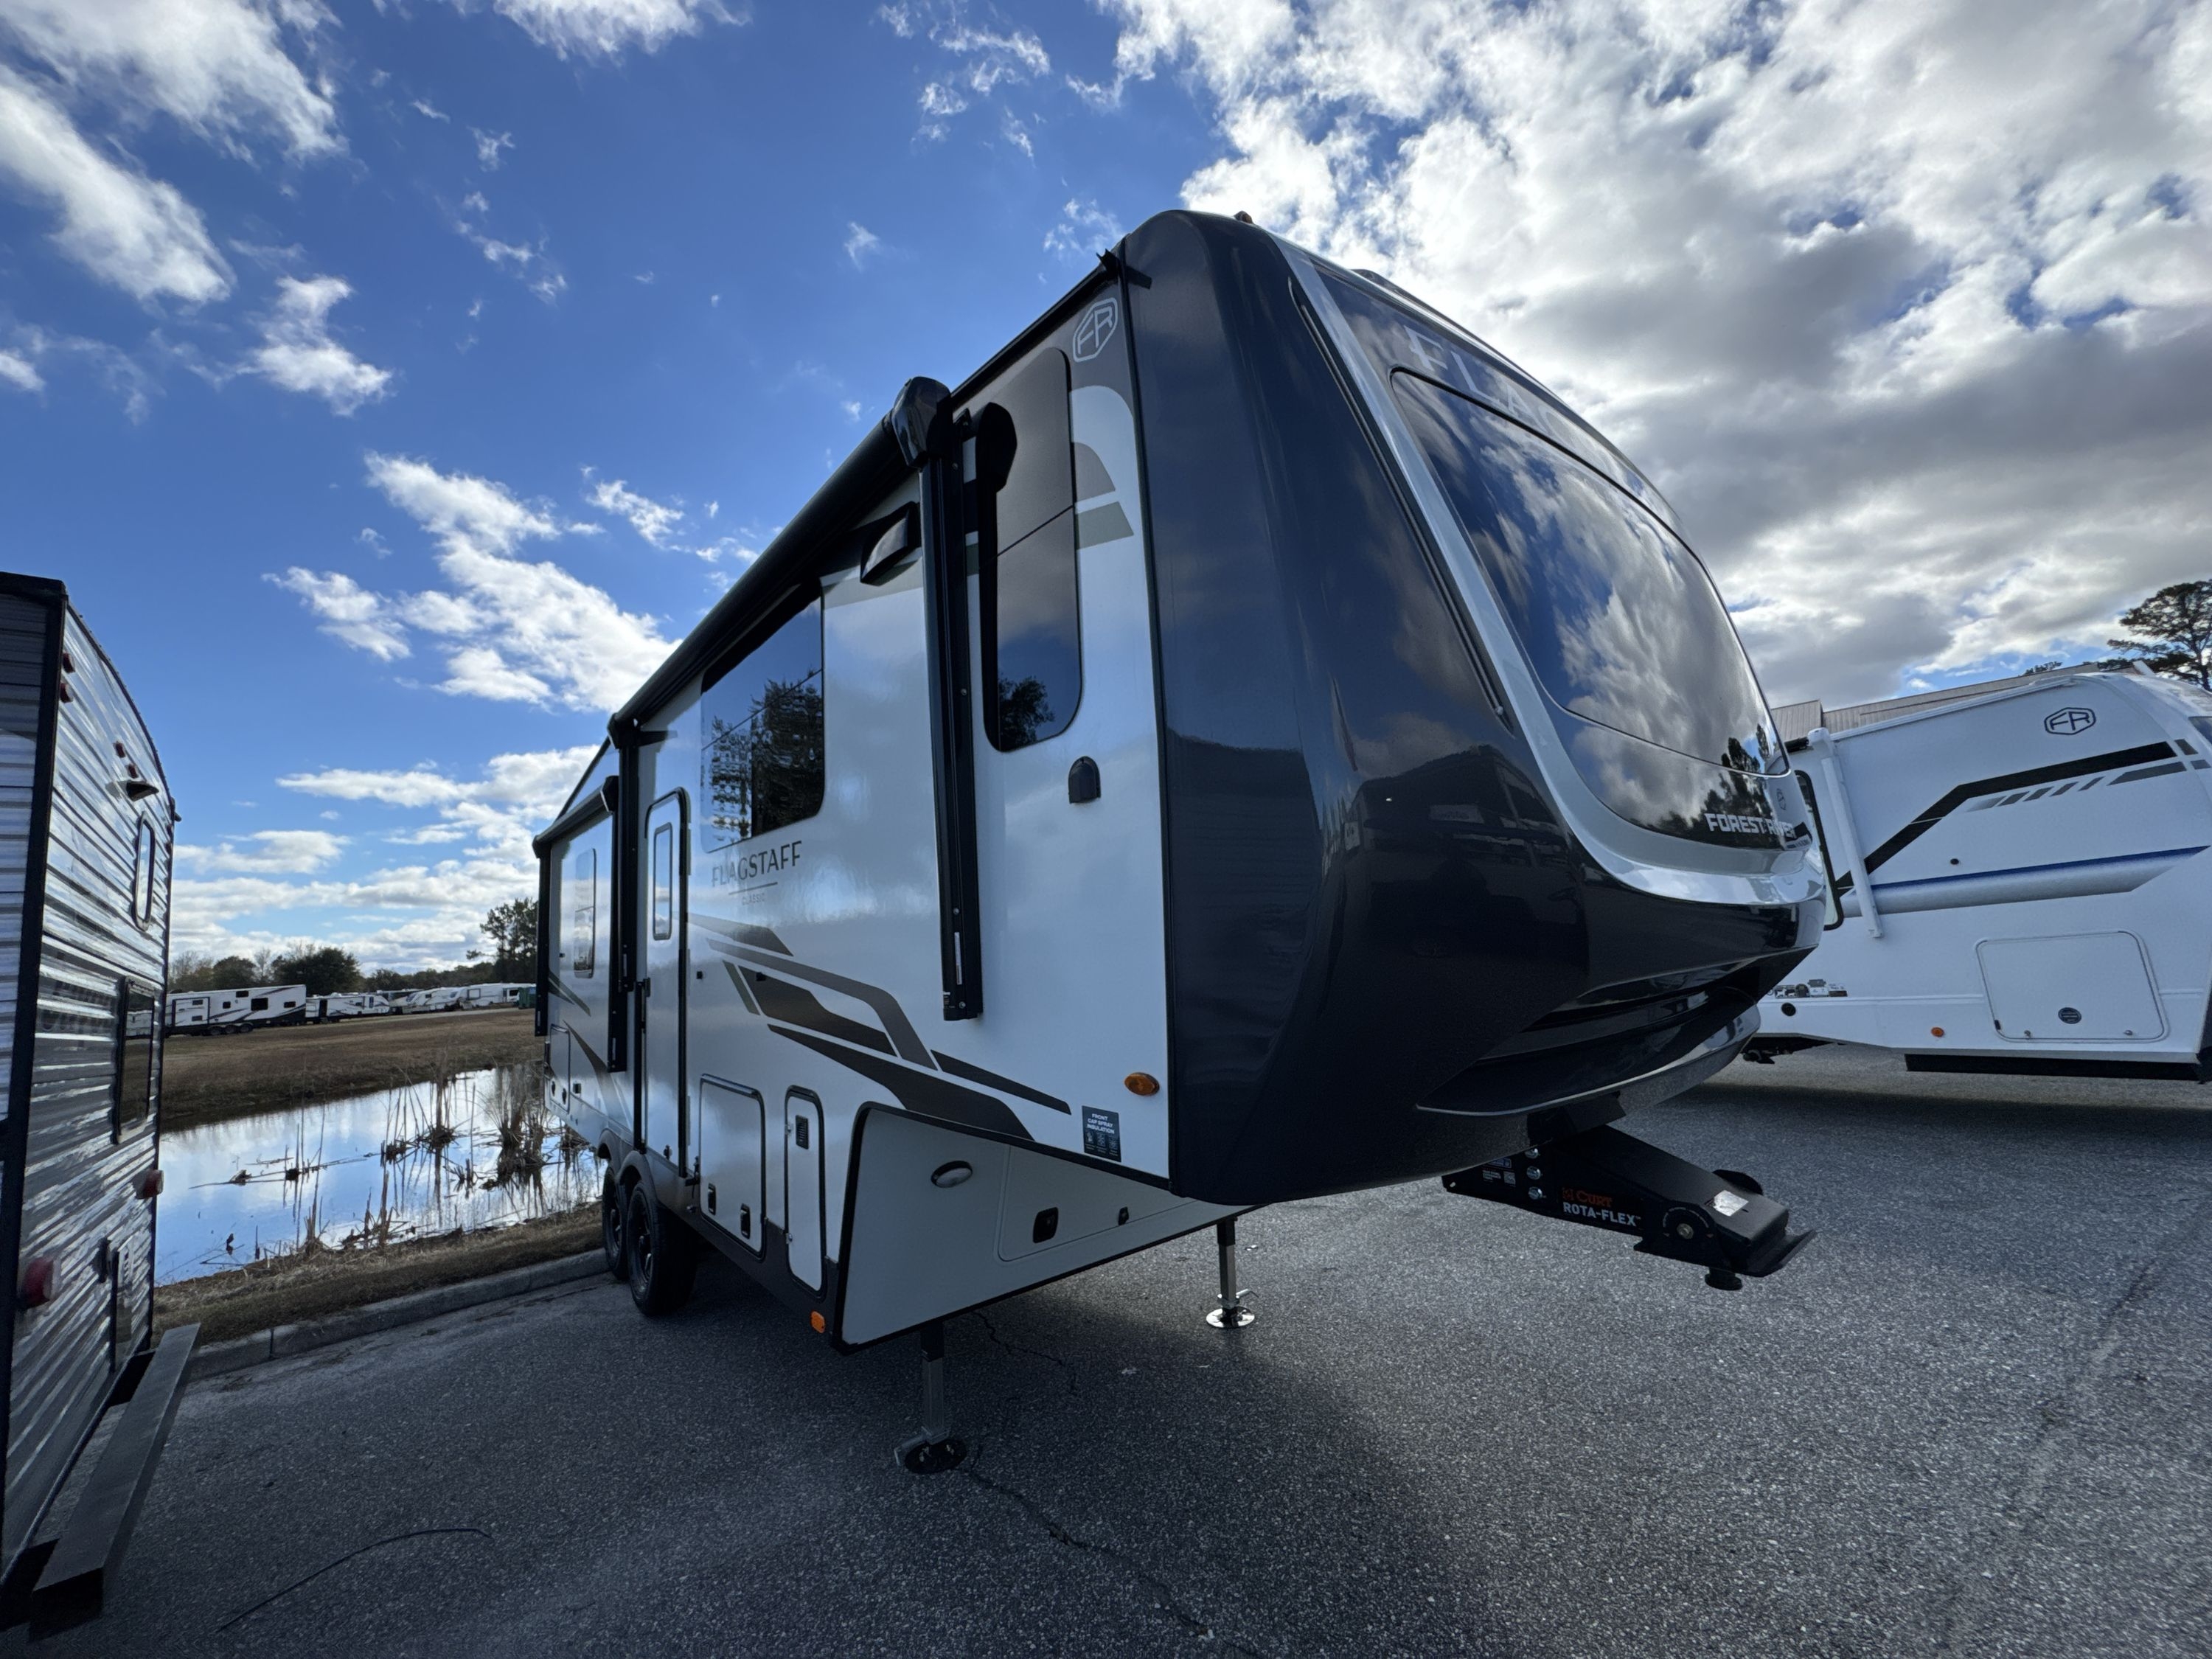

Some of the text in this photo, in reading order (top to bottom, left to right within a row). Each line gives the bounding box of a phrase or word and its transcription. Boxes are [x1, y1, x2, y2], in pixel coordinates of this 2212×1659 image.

[1077, 305, 1113, 355] FR
[2049, 711, 2091, 731] FR
[1704, 813, 1765, 835] FOREST
[712, 841, 802, 887] FLAGSTAFF
[1086, 1124, 1115, 1134] INSULATION
